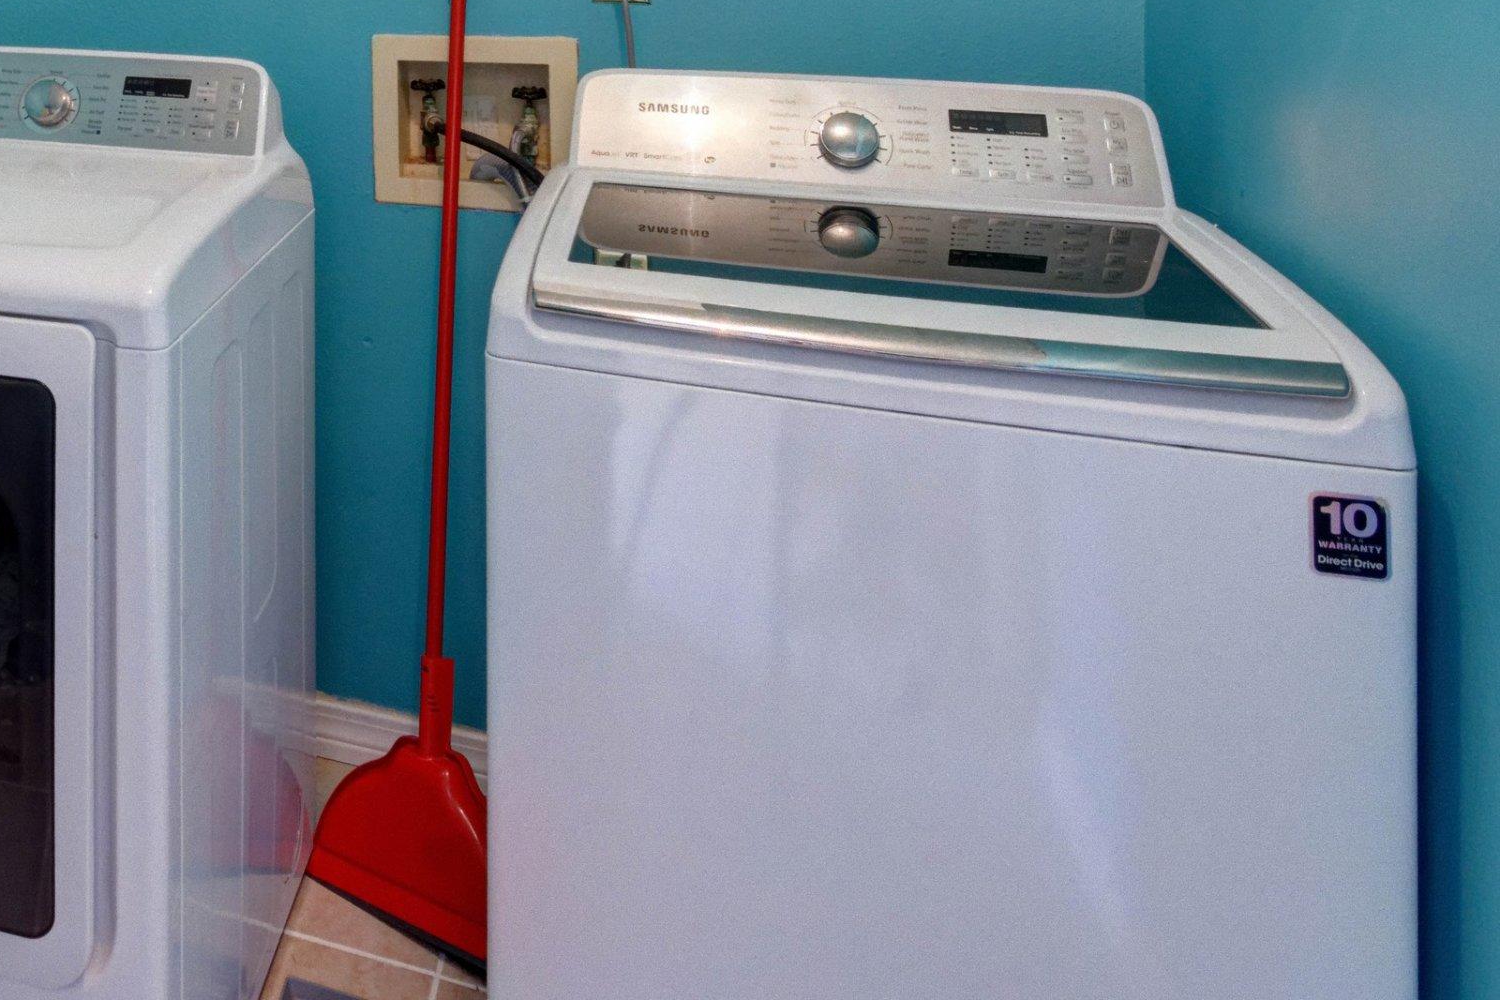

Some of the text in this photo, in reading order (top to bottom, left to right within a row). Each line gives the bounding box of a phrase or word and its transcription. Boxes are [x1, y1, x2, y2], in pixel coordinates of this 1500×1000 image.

[638, 101, 711, 116] SAMSUNG
[1320, 500, 1379, 539] 10
[1318, 540, 1383, 555] WARRANTY
[1317, 555, 1352, 567] Direct
[1354, 558, 1384, 571] Drive
